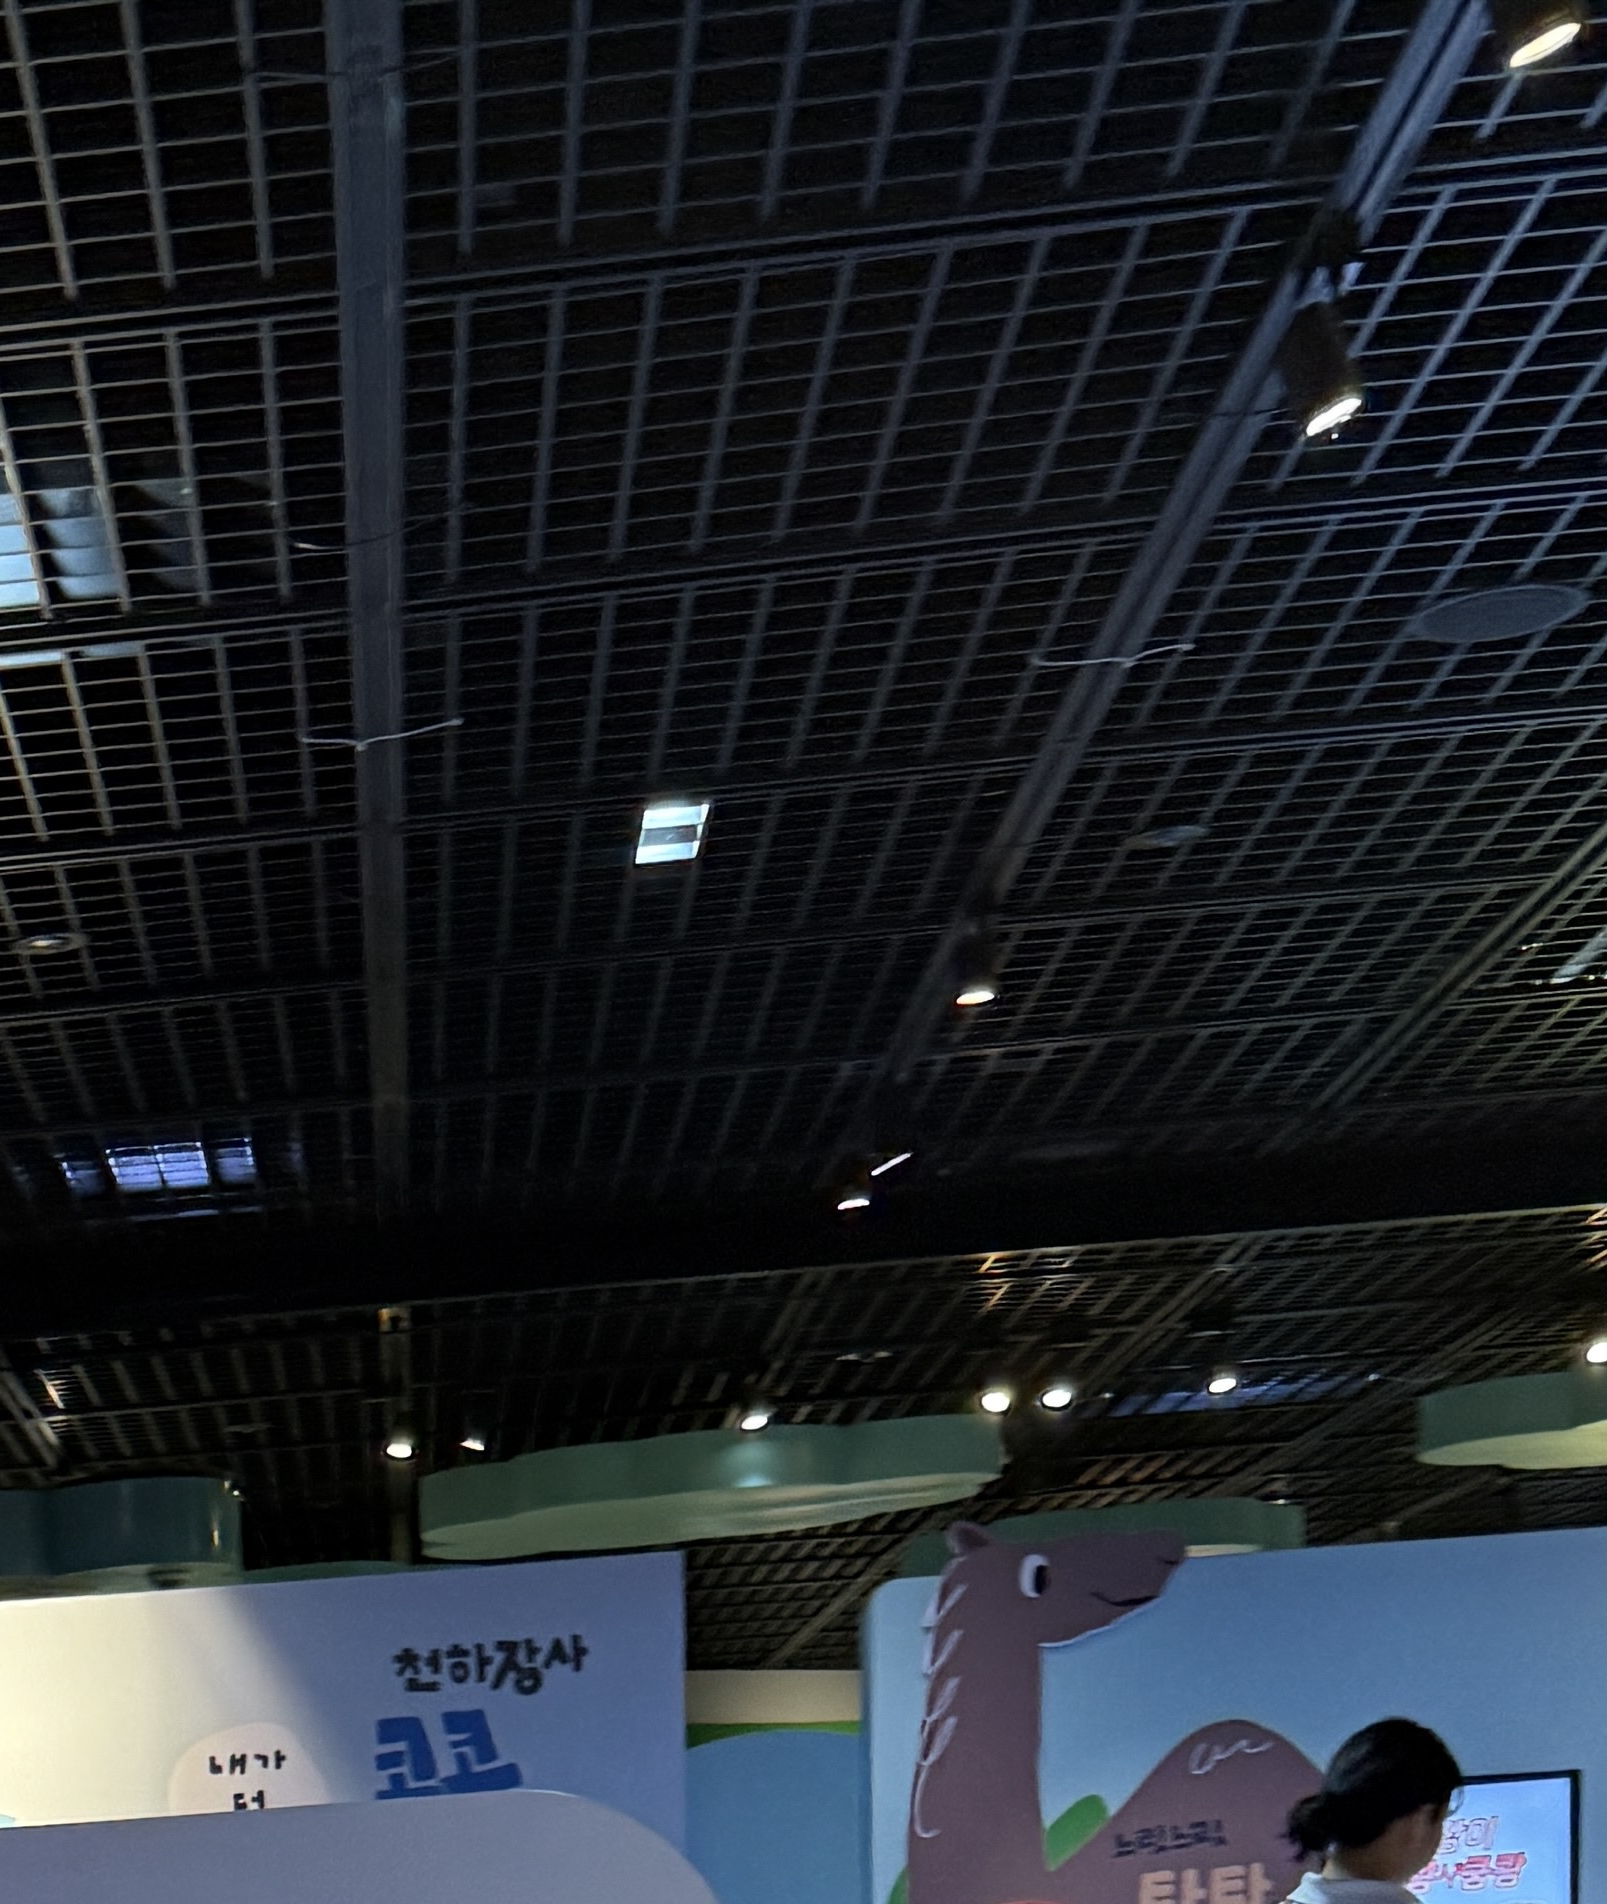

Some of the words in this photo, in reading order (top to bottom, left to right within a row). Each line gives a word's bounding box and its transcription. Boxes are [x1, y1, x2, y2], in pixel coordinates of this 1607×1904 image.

[393, 1634, 589, 1694] 천하장사
[208, 1749, 286, 1776] 내가
[375, 1709, 523, 1801] 코코
